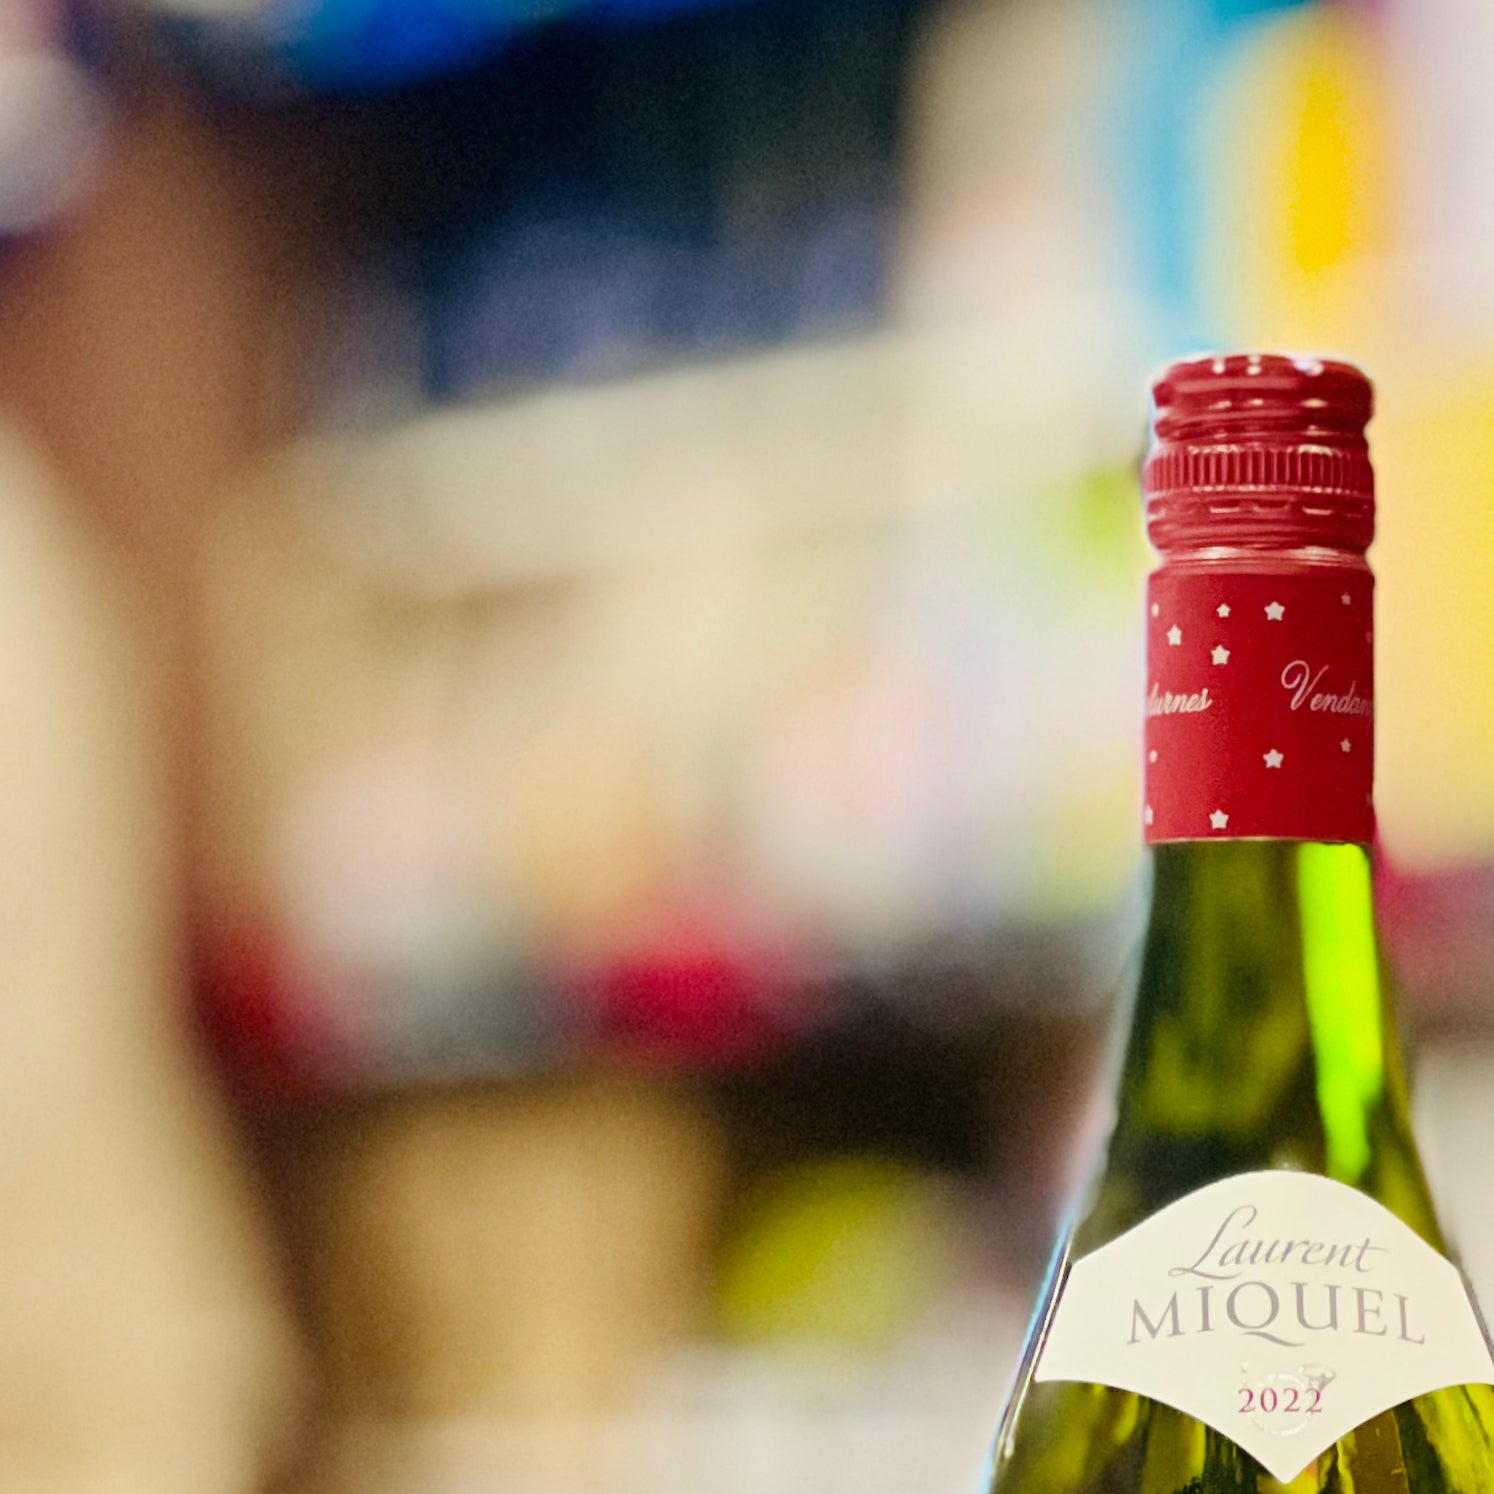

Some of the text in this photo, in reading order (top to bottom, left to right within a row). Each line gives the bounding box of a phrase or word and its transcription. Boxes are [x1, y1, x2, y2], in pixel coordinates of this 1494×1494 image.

[1168, 1204, 1390, 1280] Laurent
[1126, 1281, 1426, 1347] MIQUEL
[1238, 1387, 1322, 1414] 2022
